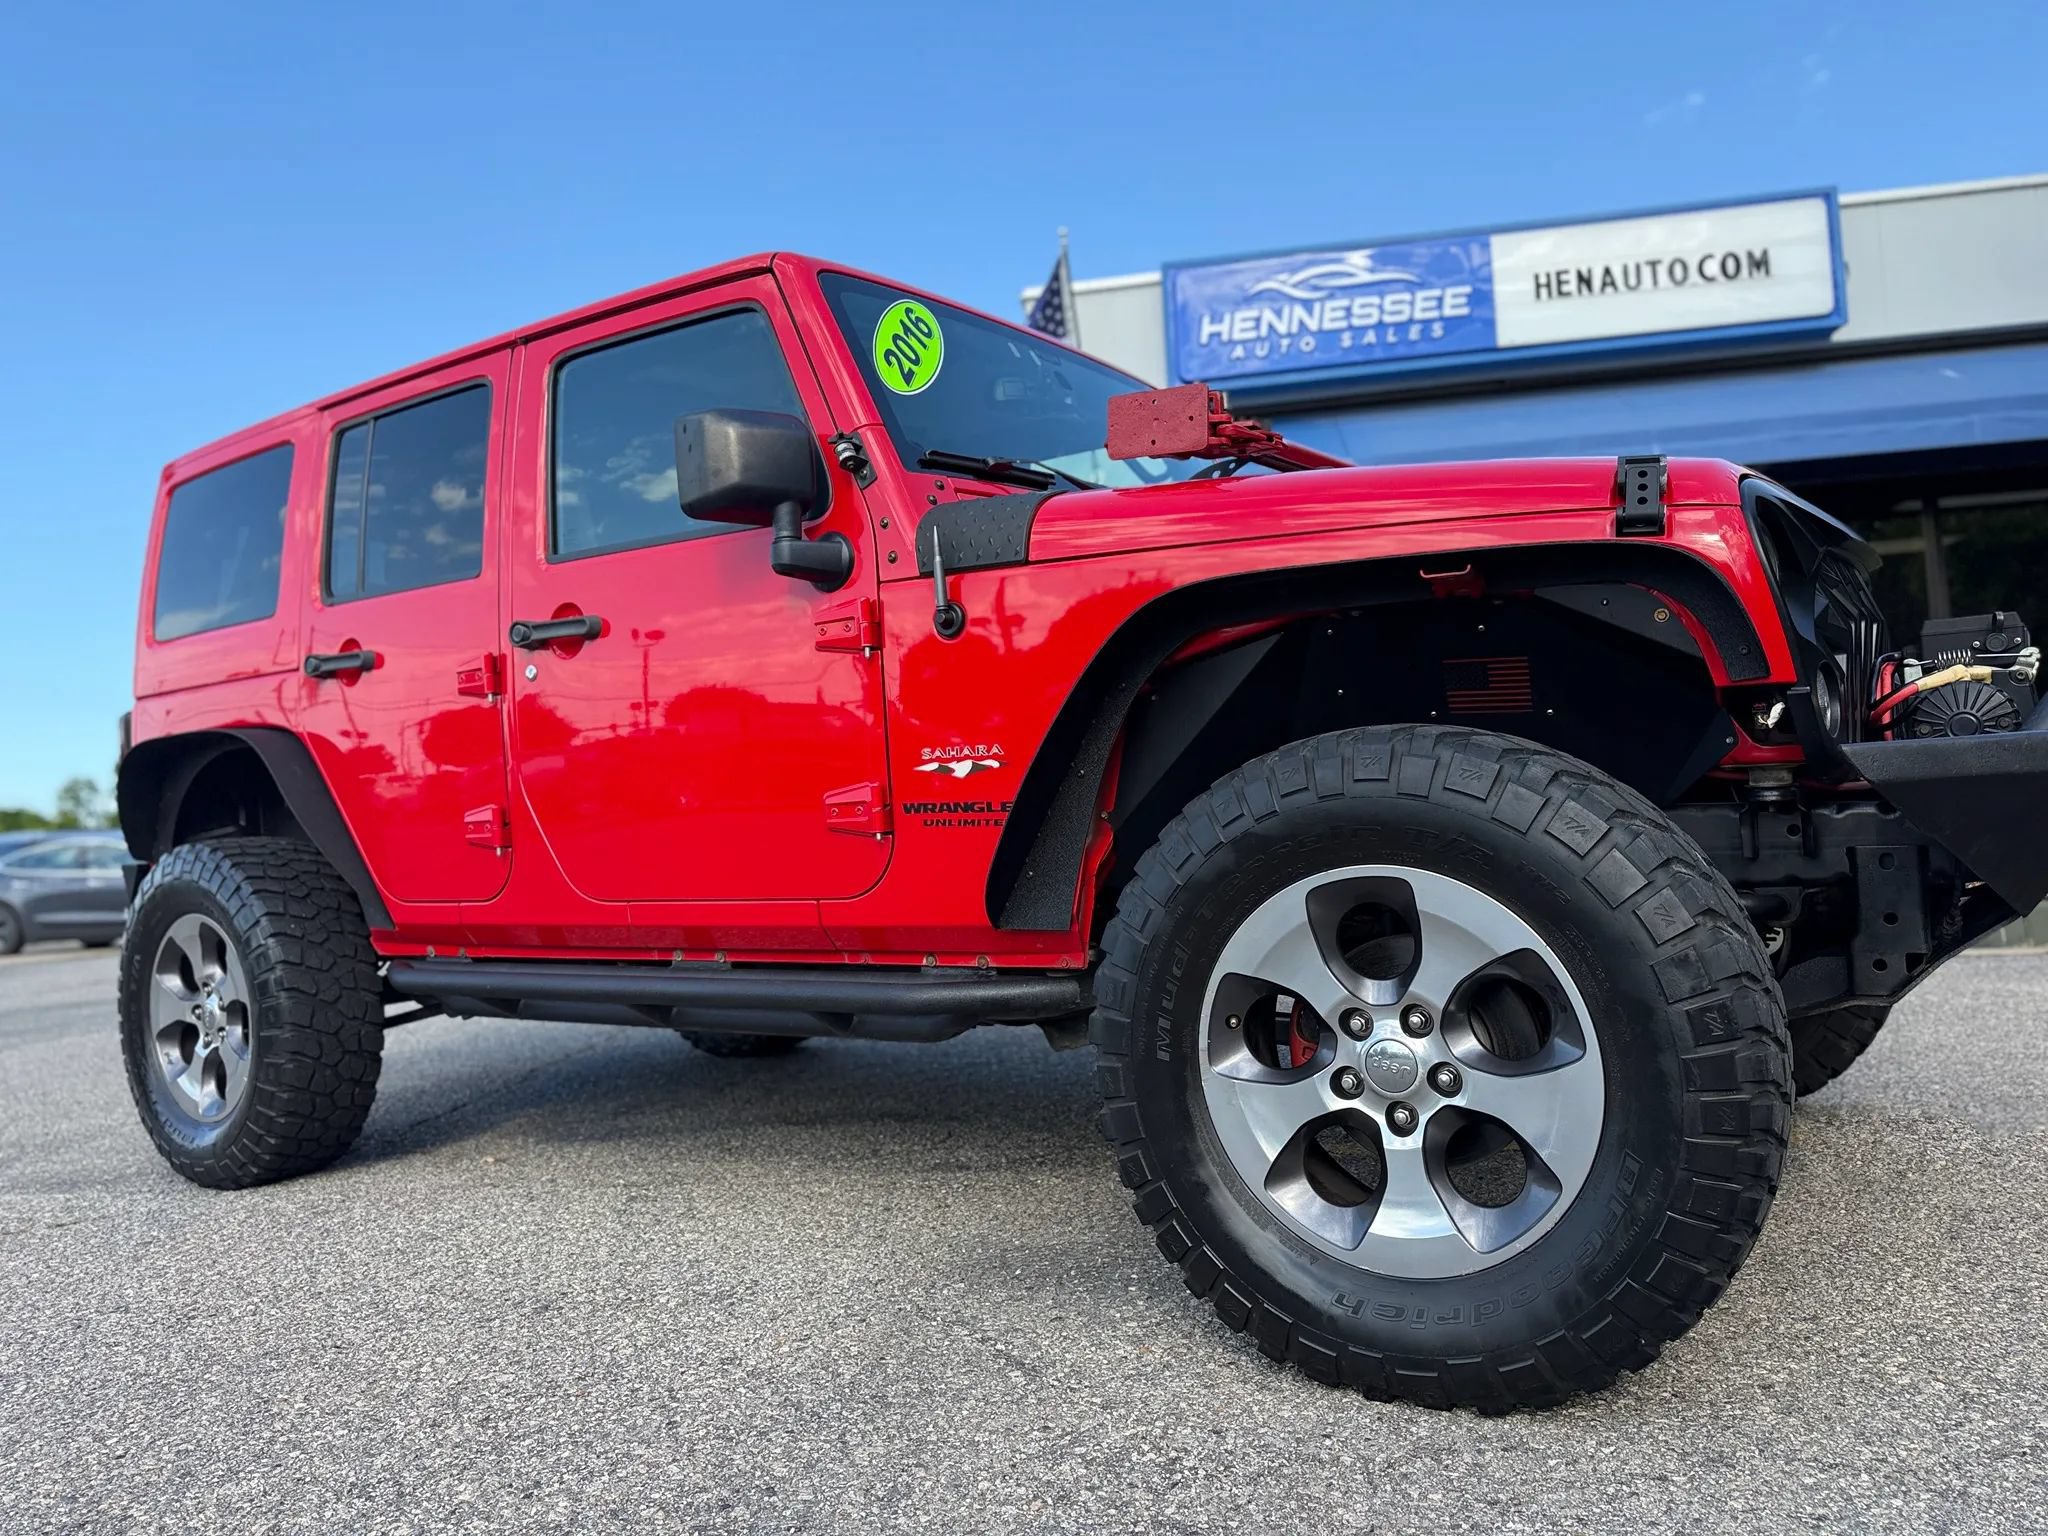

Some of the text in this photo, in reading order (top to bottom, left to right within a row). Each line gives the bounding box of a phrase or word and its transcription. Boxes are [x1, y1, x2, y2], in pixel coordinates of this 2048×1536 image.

[1200, 285, 1472, 345] HENNESSEE
[883, 306, 935, 388] 2016
[1230, 321, 1445, 361] AUTO SALES
[921, 743, 1005, 760] SAHARA
[902, 801, 1014, 815] WRANGLE
[923, 818, 1004, 828] UNLIMITE
